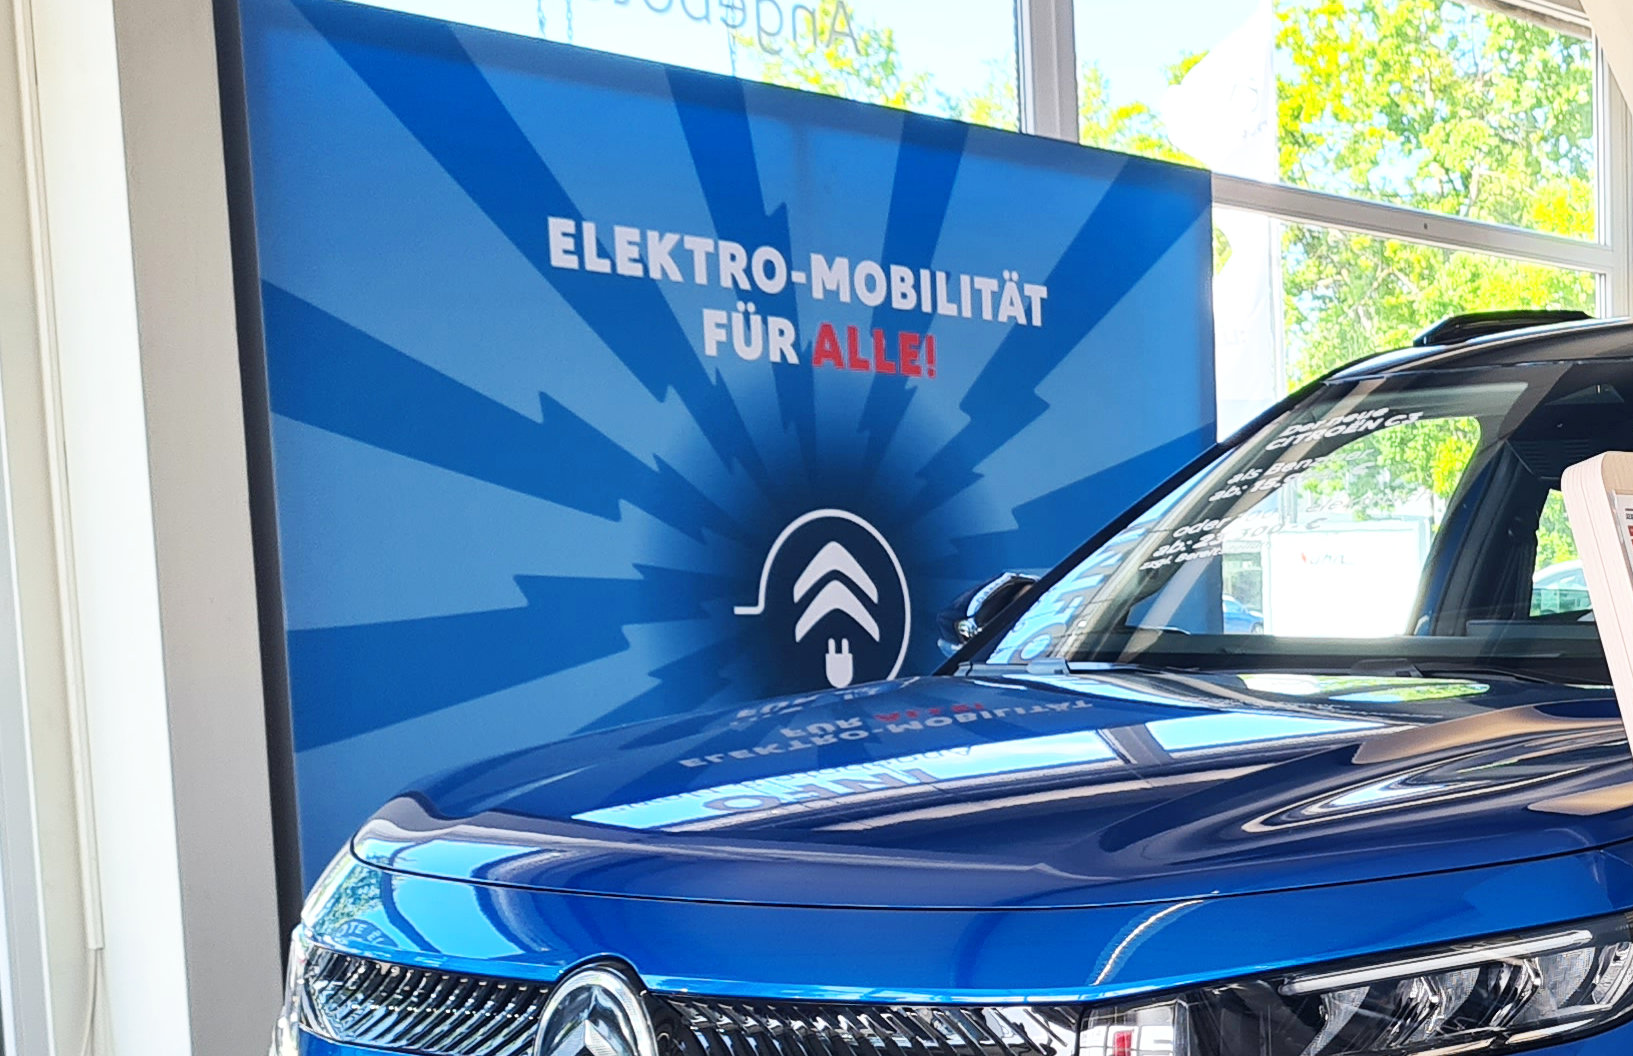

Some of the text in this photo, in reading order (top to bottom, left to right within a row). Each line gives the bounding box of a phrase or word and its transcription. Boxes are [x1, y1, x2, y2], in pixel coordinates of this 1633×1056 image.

[546, 215, 1048, 328] ELEKTRO-MOBILITÄT
[701, 302, 940, 380] FÜR ALLE!
[1265, 416, 1384, 451] CITROËN
